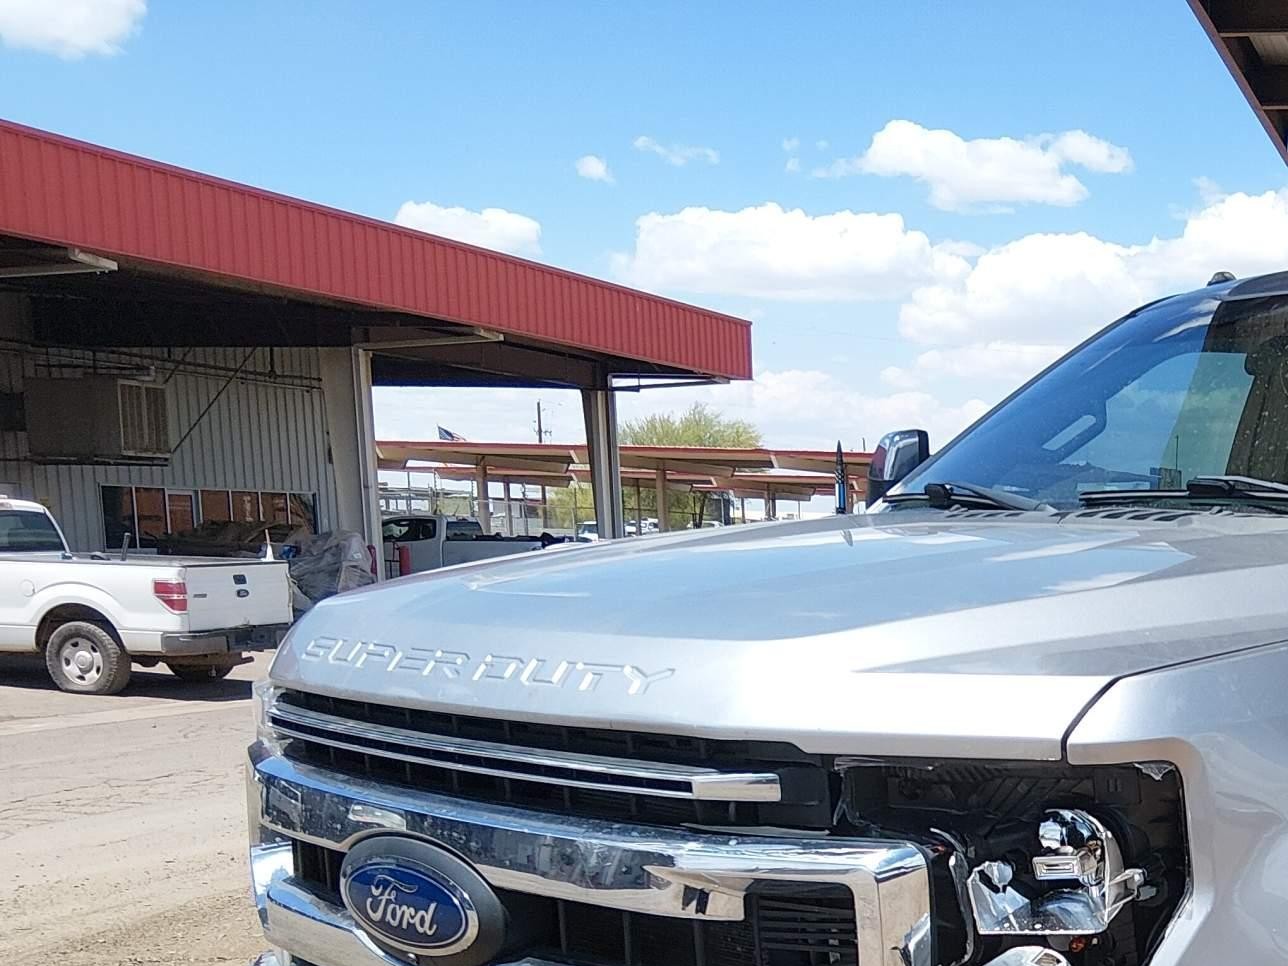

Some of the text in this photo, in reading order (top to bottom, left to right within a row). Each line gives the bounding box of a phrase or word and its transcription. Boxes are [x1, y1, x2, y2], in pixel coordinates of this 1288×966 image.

[302, 636, 677, 696] SUPER DUTY
[366, 874, 437, 936] Ford
